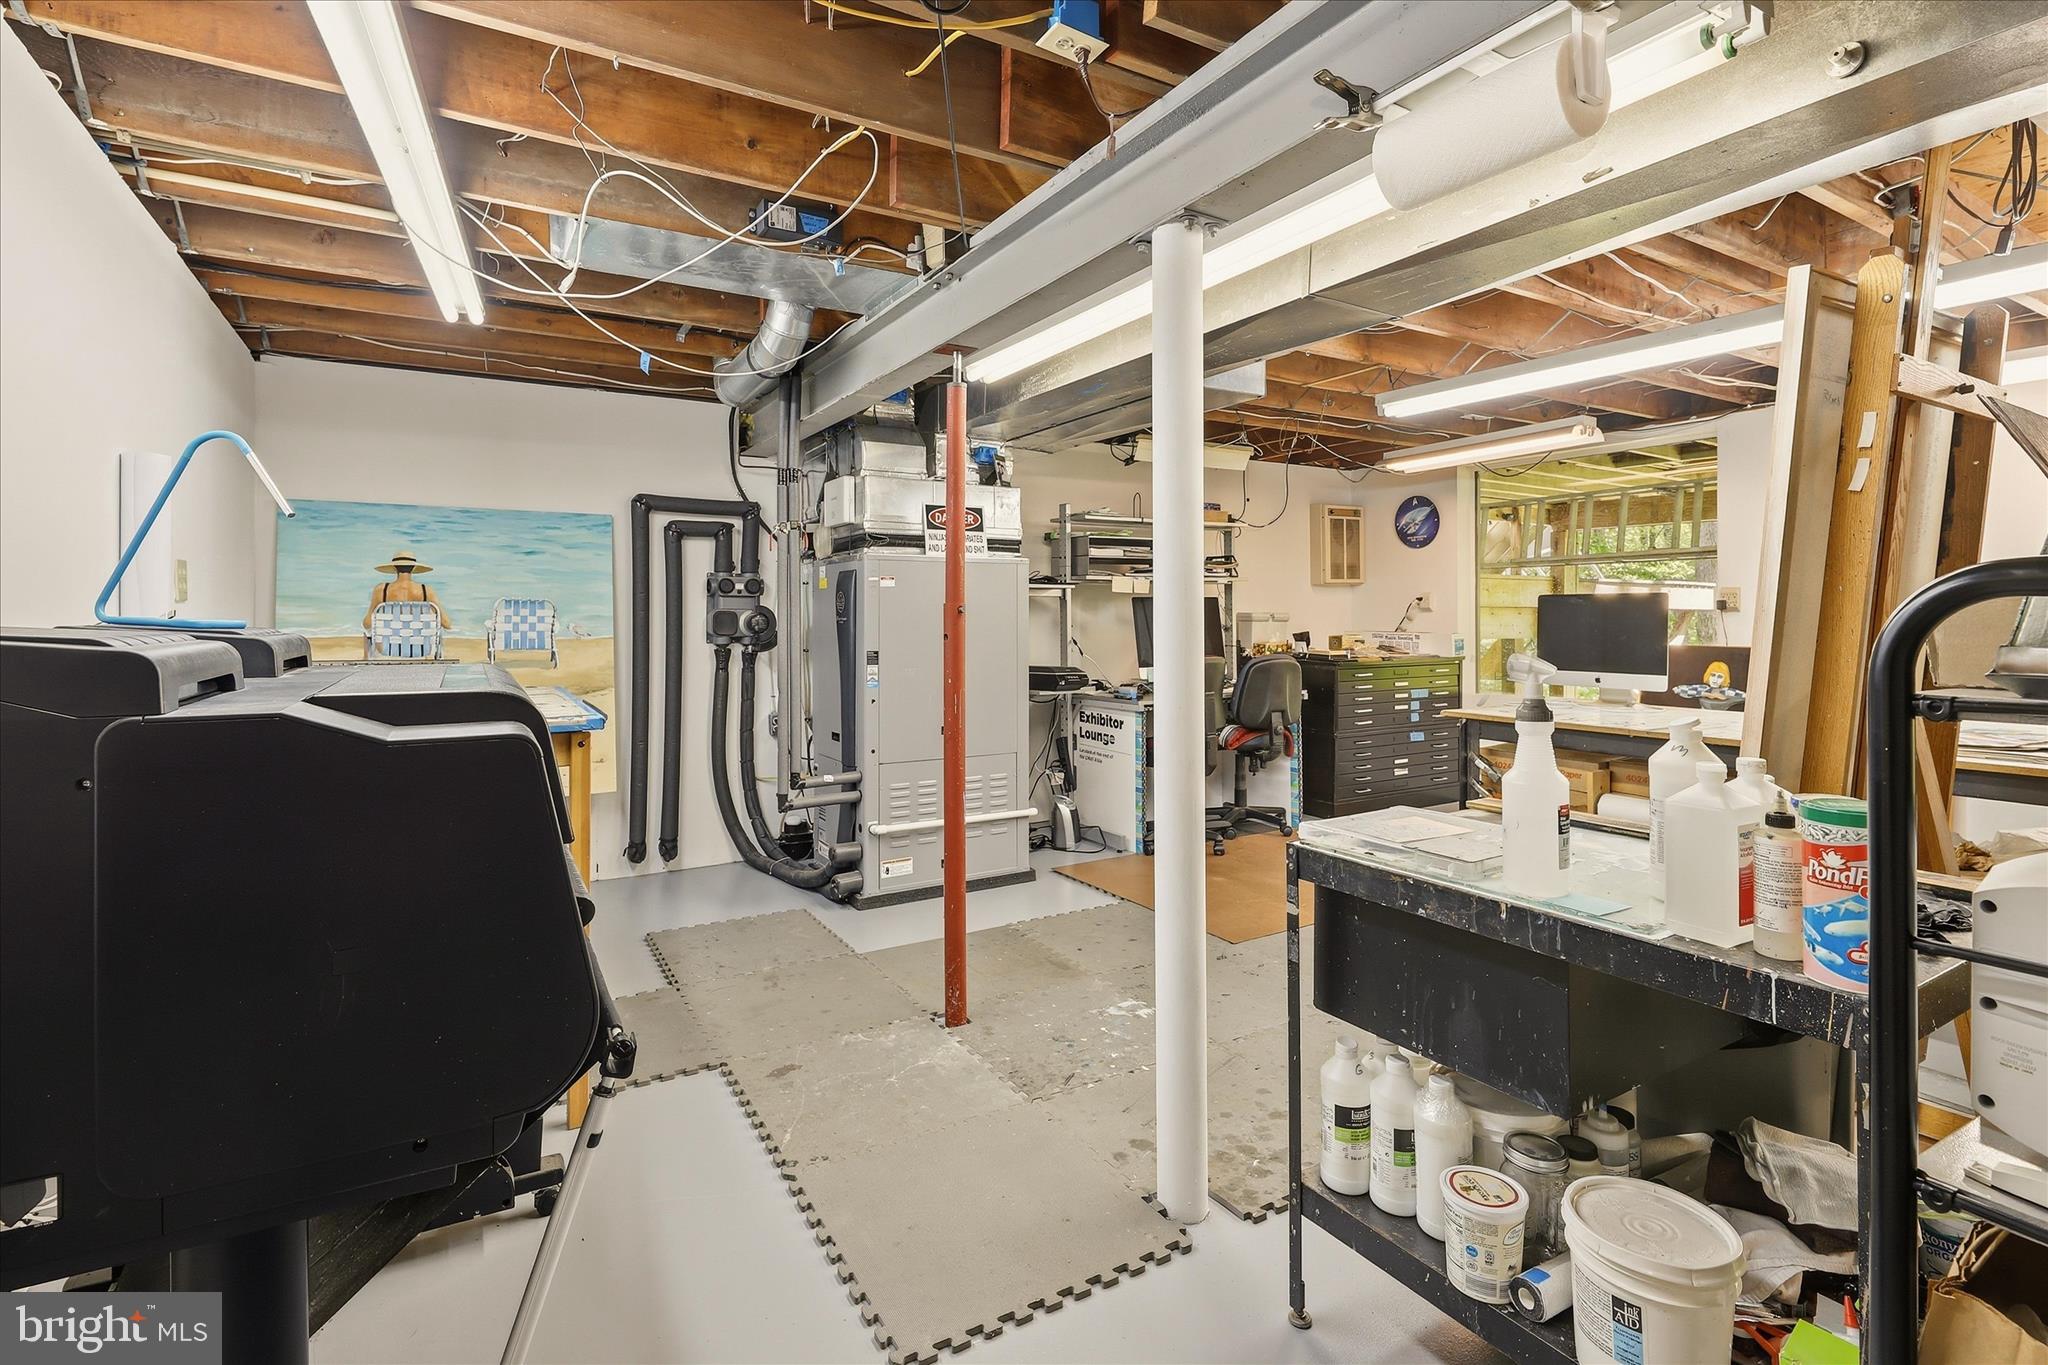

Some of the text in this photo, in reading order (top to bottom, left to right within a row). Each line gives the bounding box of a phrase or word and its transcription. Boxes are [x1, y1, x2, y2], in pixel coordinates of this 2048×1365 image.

[1080, 711, 1124, 729] Exhibitor
[1080, 727, 1115, 745] Lounge
[1808, 859, 1870, 886] PondF
[1926, 1246, 1953, 1261] ORG
